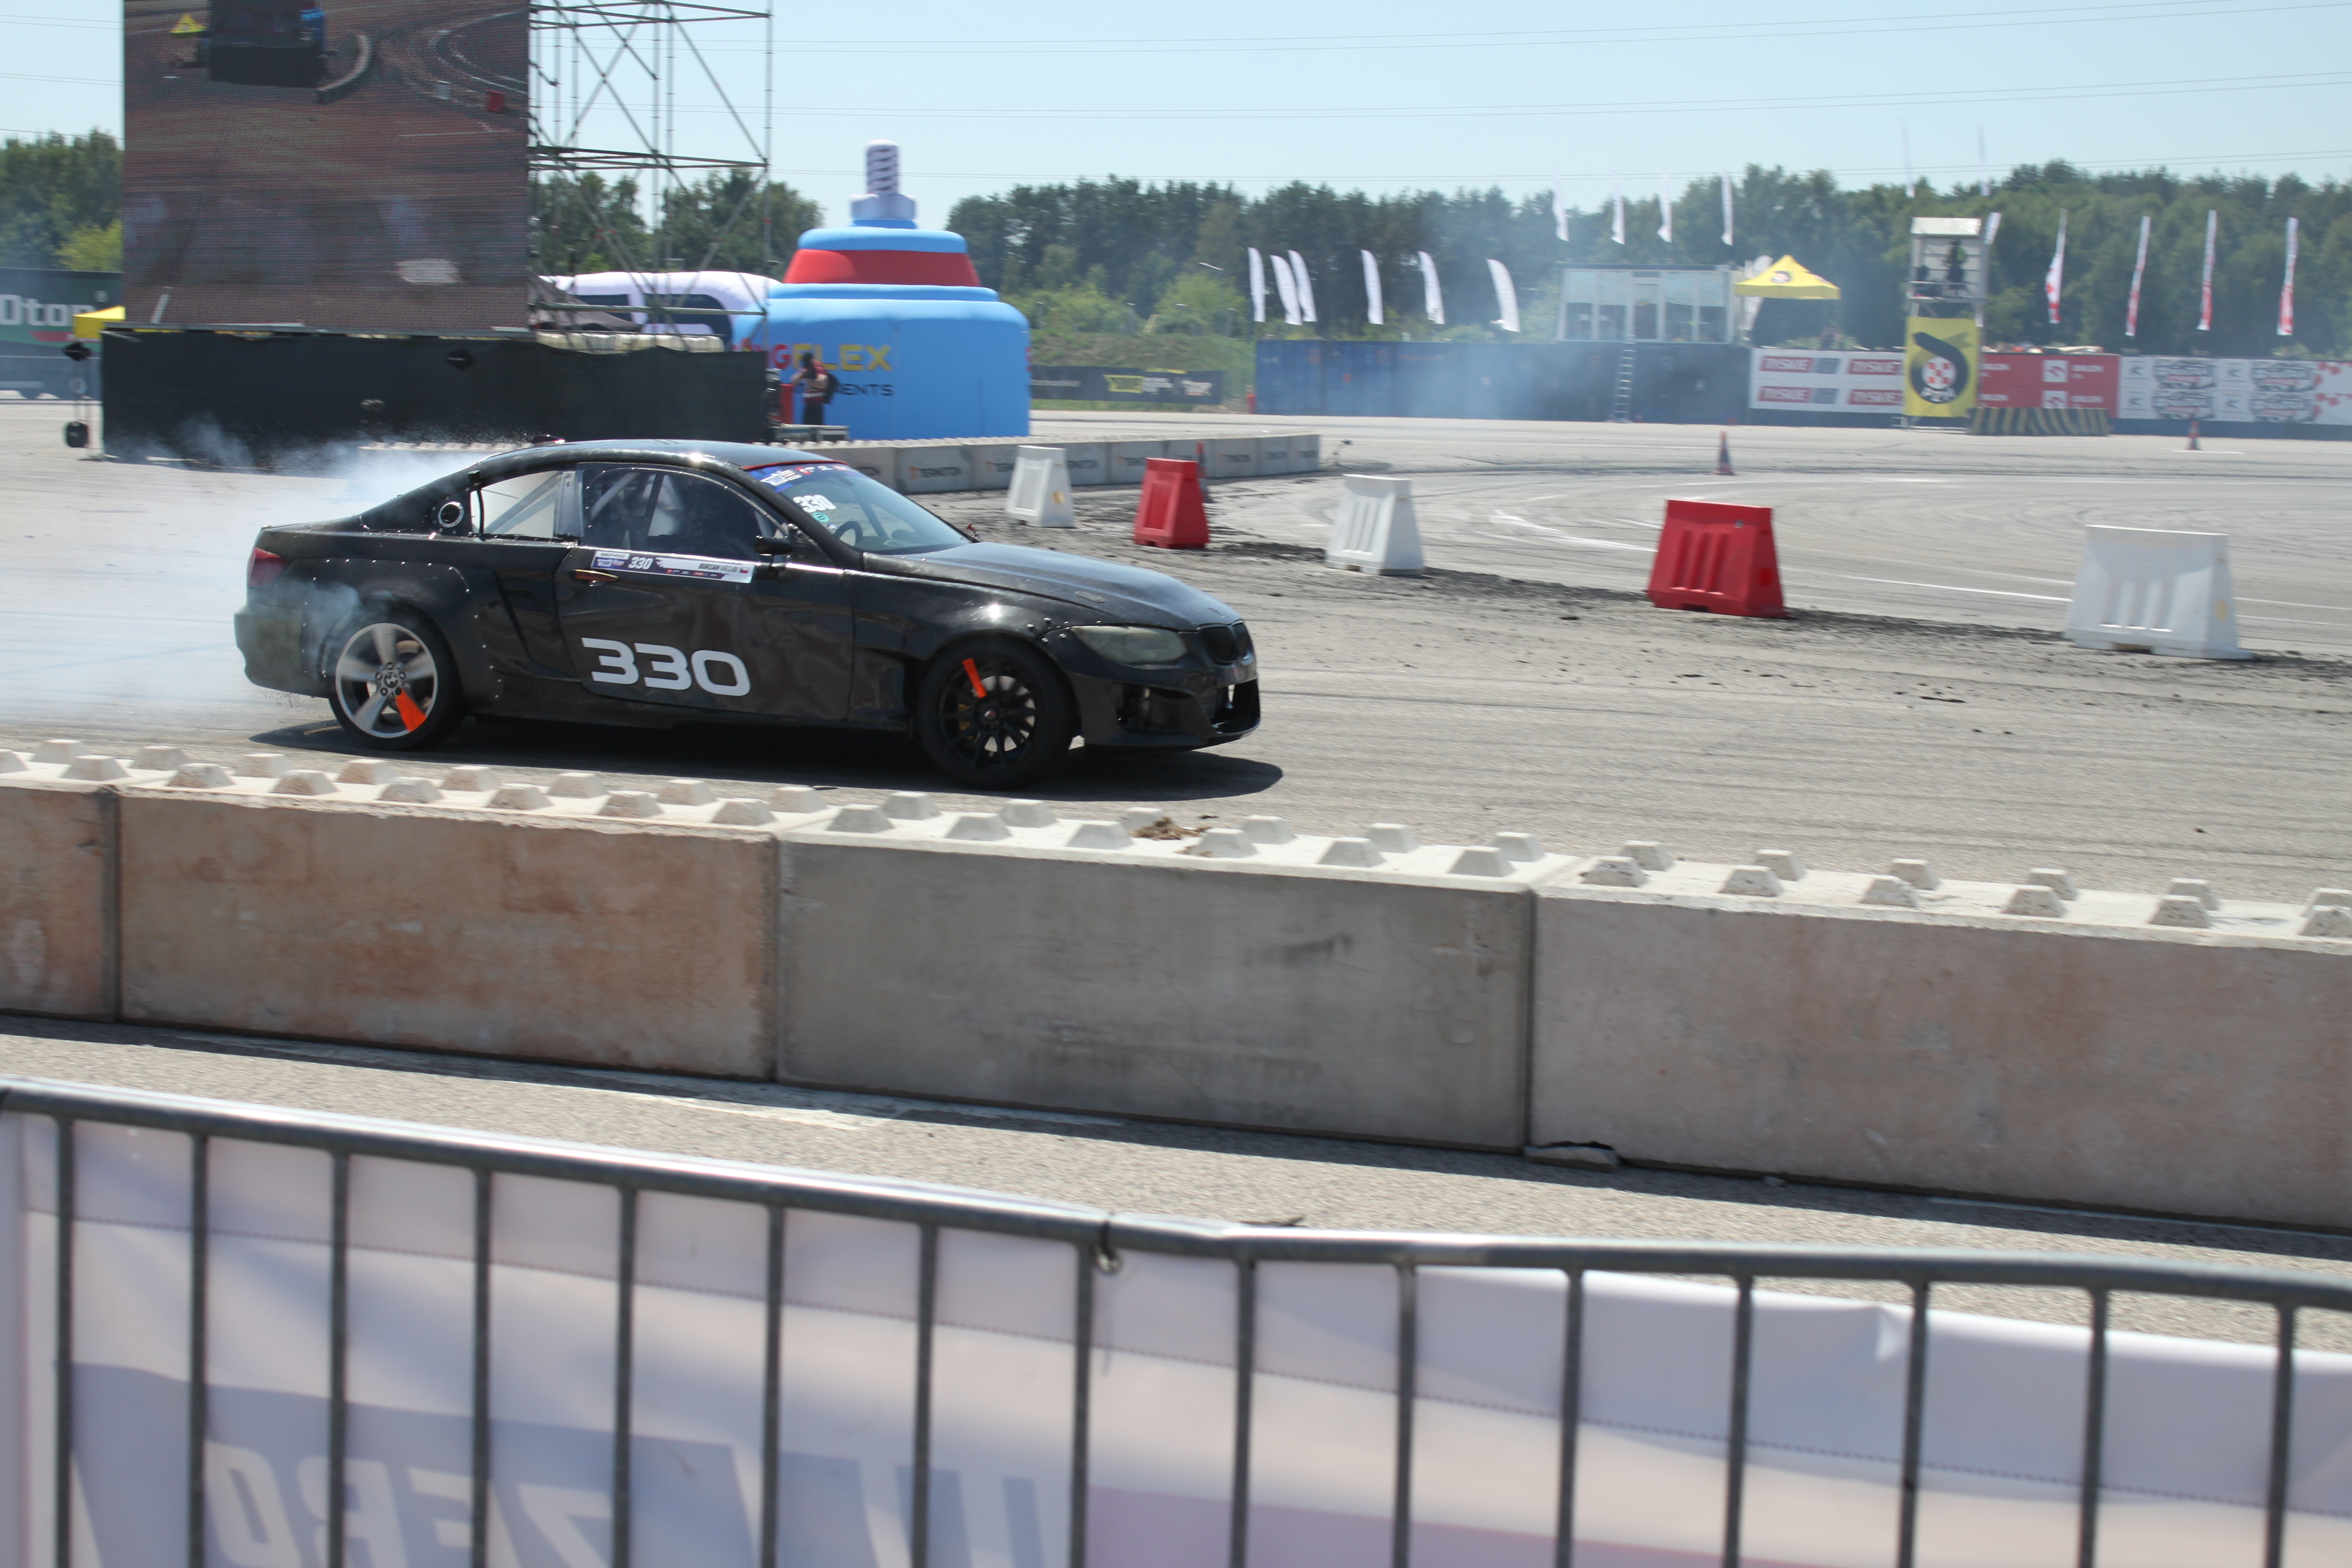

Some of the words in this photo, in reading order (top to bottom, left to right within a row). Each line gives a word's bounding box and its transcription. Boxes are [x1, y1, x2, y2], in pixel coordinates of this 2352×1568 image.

[793, 494, 837, 513] 330
[629, 556, 653, 570] 330
[581, 637, 751, 696] 330
